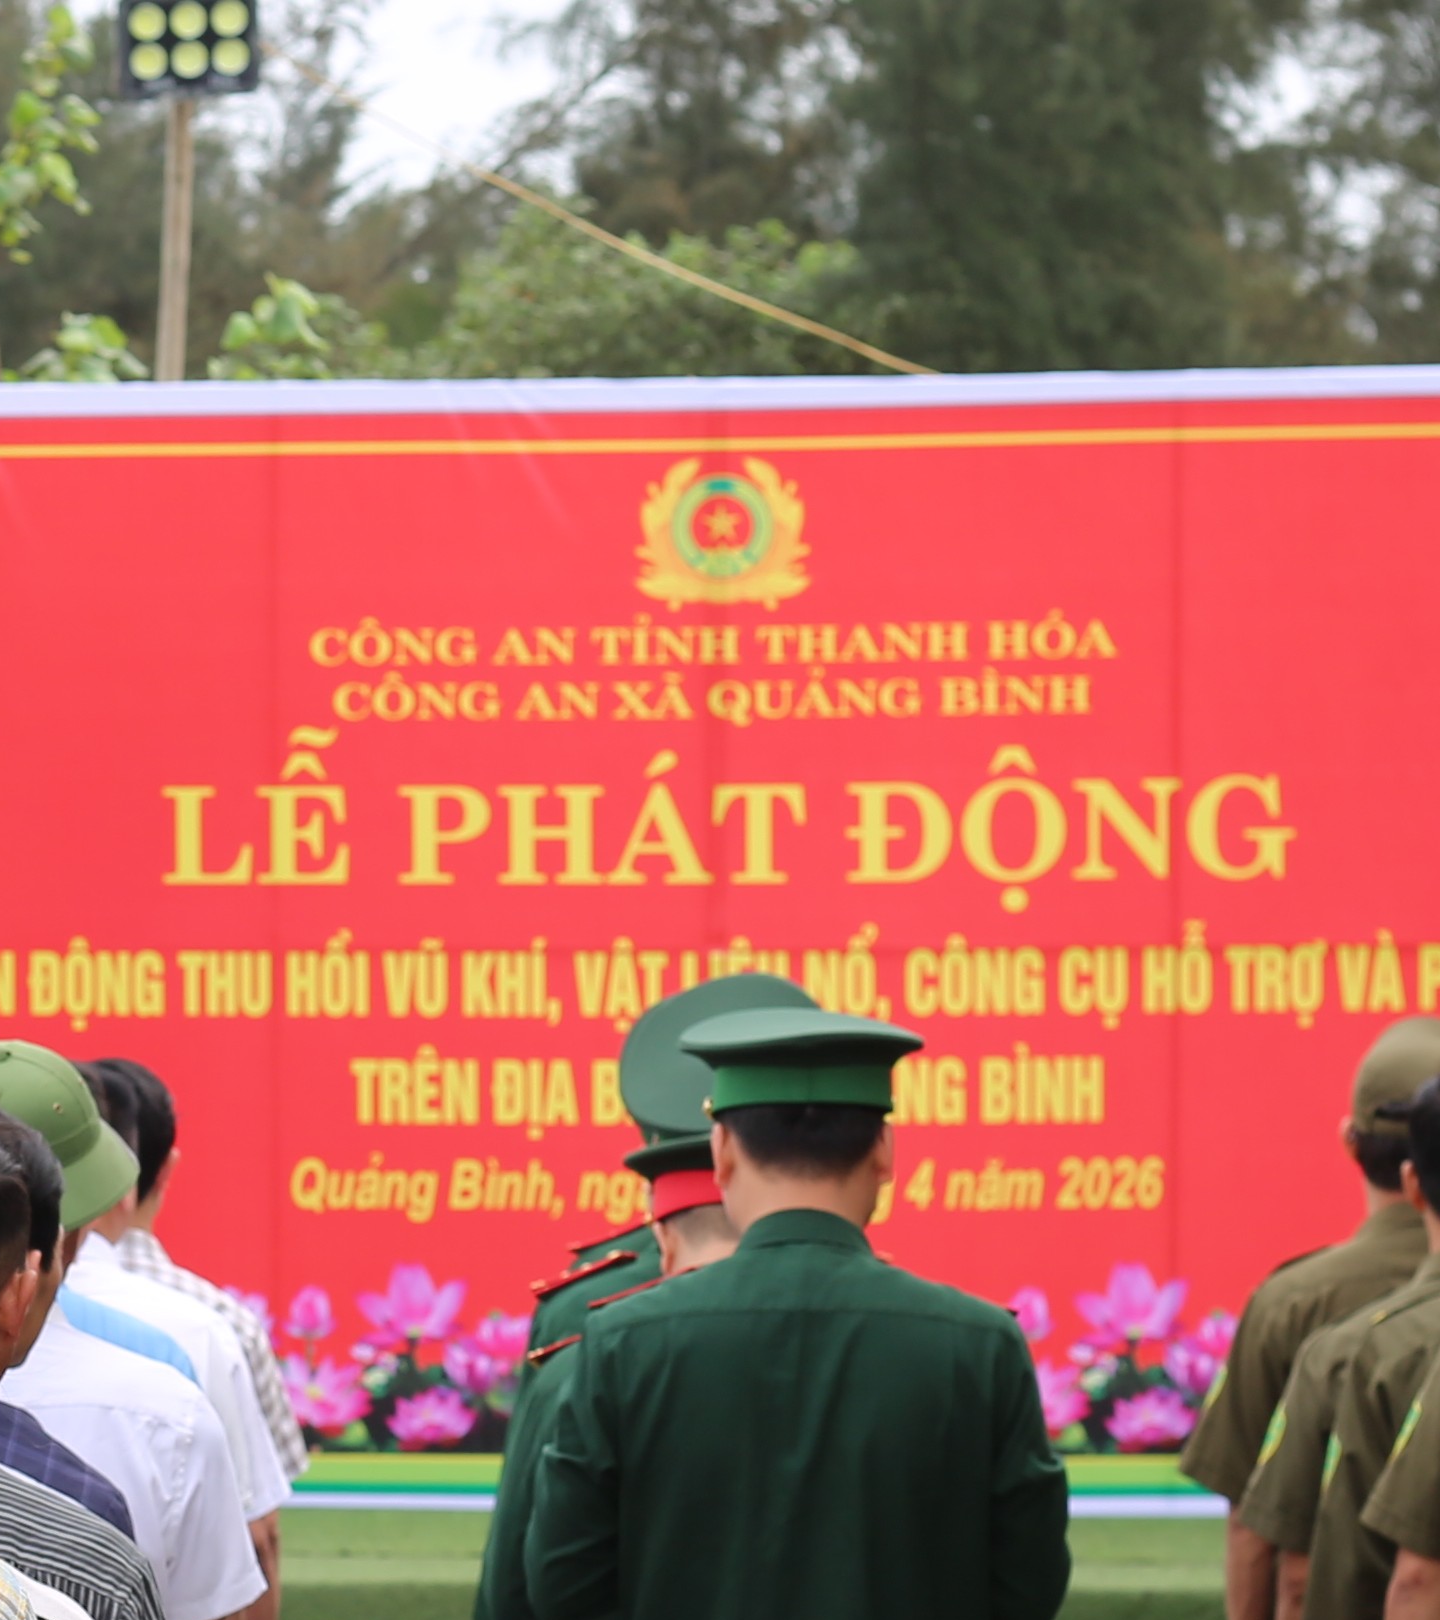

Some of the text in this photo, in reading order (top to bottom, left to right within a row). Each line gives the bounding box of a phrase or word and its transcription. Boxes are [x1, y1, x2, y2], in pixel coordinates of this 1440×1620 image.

[308, 609, 1118, 667] CÔNG AN TỈNH THANH HÓA
[331, 665, 1091, 728] CÔNG AN XÃ QUẢNG BÌNH
[162, 725, 1296, 914] LỄ PHÁT ĐỘNG
[26, 935, 167, 1032] ĐỘNG
[176, 949, 273, 1019] THU
[381, 937, 450, 1019] VŨ
[460, 936, 563, 1026] KHÍ,
[573, 935, 670, 1034] VẬT
[904, 933, 1047, 1017] CÔNG
[1057, 945, 1130, 1030] CỤ
[1224, 938, 1328, 1029] TRỢ
[1336, 928, 1407, 1013] VÀ
[348, 1043, 481, 1126] TRÊN
[490, 1057, 580, 1141] ĐỊA
[979, 1042, 1106, 1126] BÌNH
[290, 1150, 440, 1224] Quảng
[447, 1156, 566, 1219] Bình,
[904, 1158, 936, 1210] 4
[944, 1157, 1045, 1212] năm
[1055, 1155, 1165, 1210] 2026
